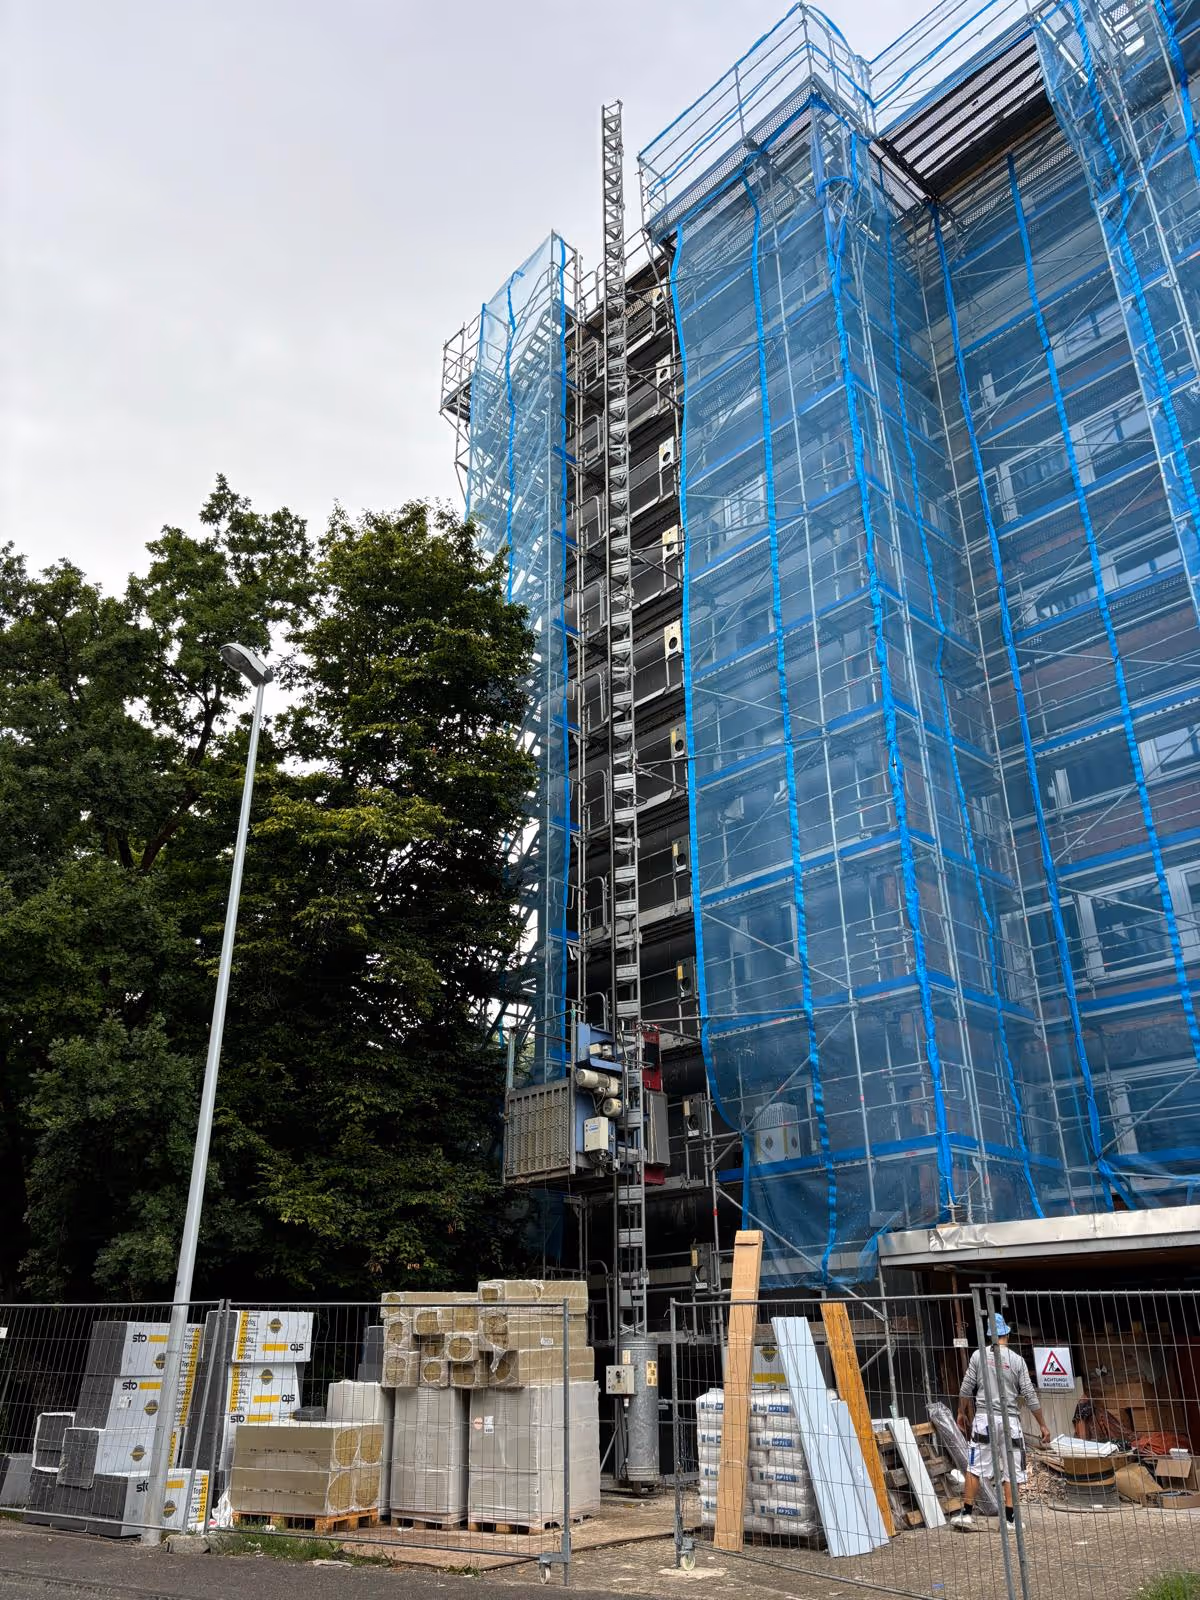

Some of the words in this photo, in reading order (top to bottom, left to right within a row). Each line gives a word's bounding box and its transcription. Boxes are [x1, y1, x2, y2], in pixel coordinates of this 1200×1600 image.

[132, 1332, 147, 1343] sto
[290, 1343, 304, 1353] sto
[122, 1379, 137, 1390] sto
[282, 1394, 295, 1404] sto
